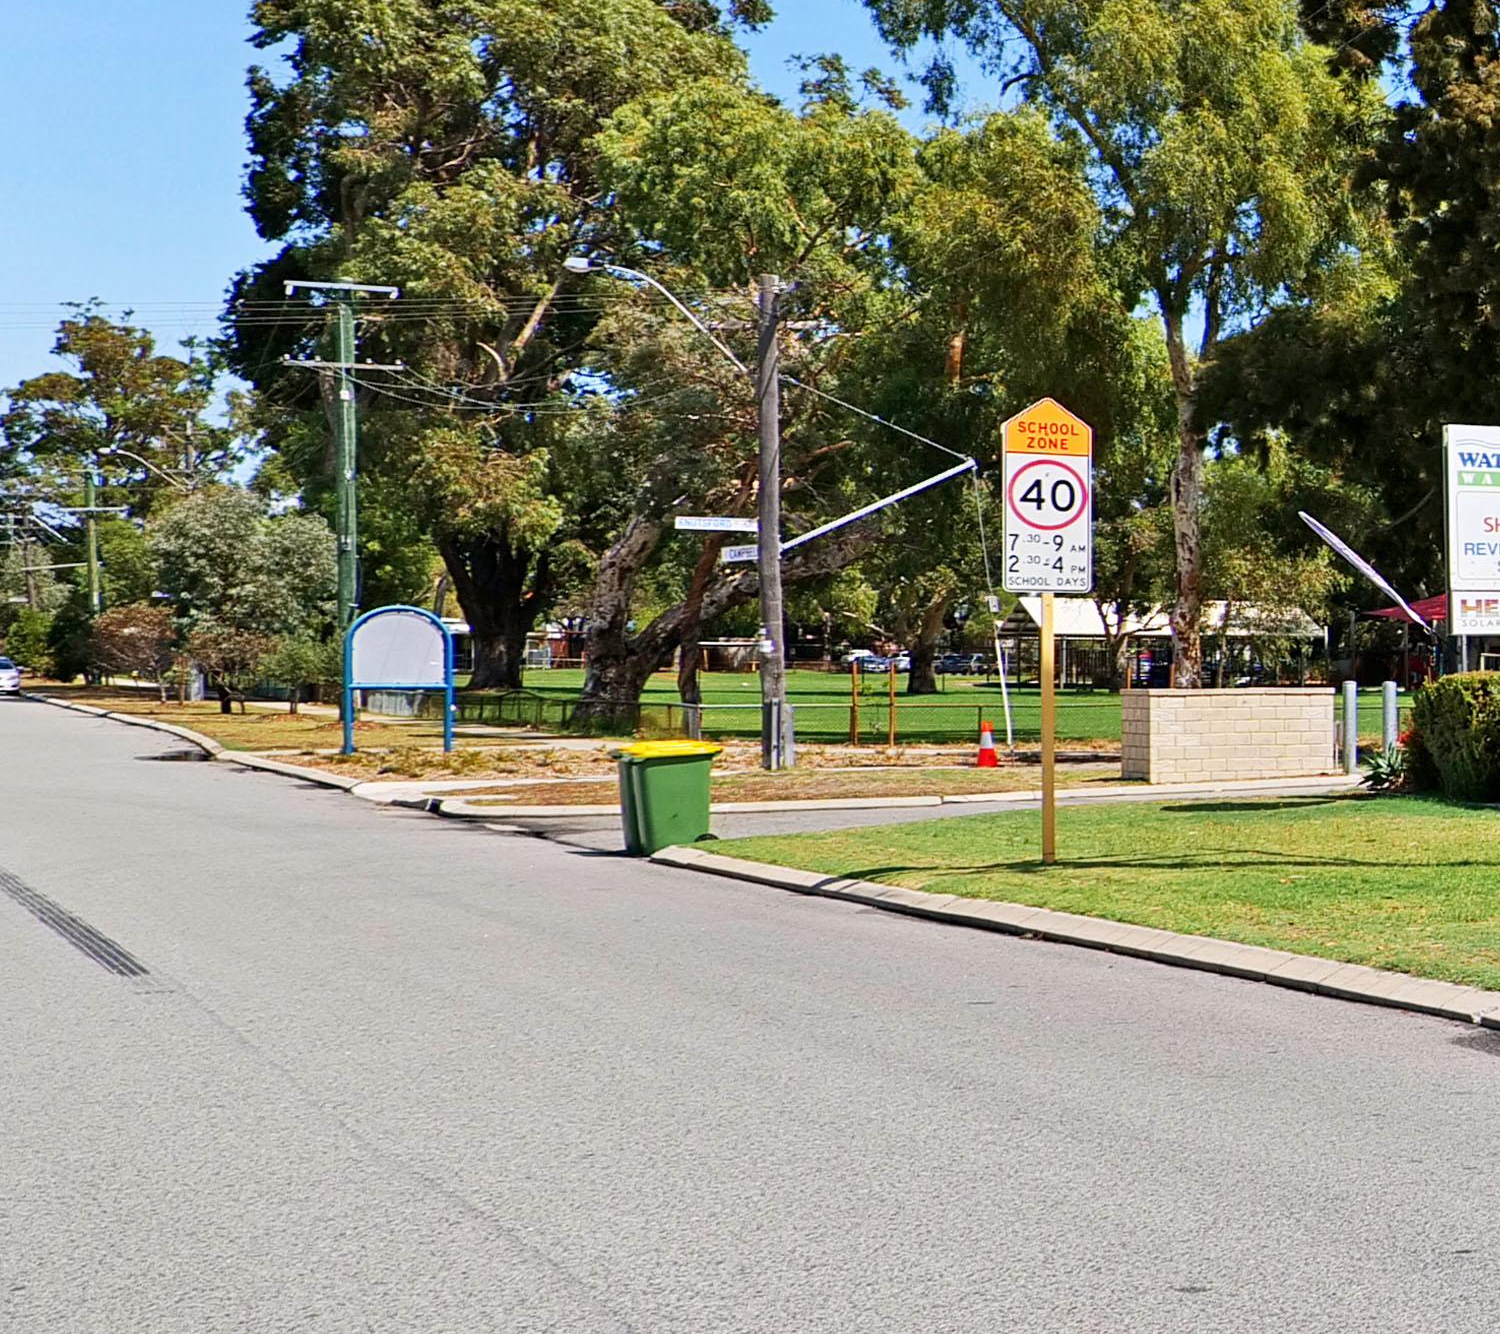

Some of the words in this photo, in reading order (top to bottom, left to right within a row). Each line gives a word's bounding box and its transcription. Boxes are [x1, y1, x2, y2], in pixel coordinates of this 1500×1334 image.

[1018, 421, 1079, 436] SCHOOL
[1027, 437, 1069, 450] ZONE
[1020, 479, 1075, 512] 40
[1071, 565, 1086, 573] PM
[1009, 576, 1050, 586] SCHOOL
[1057, 578, 1086, 587] DAYS
[1462, 619, 1500, 627] SOLAR
